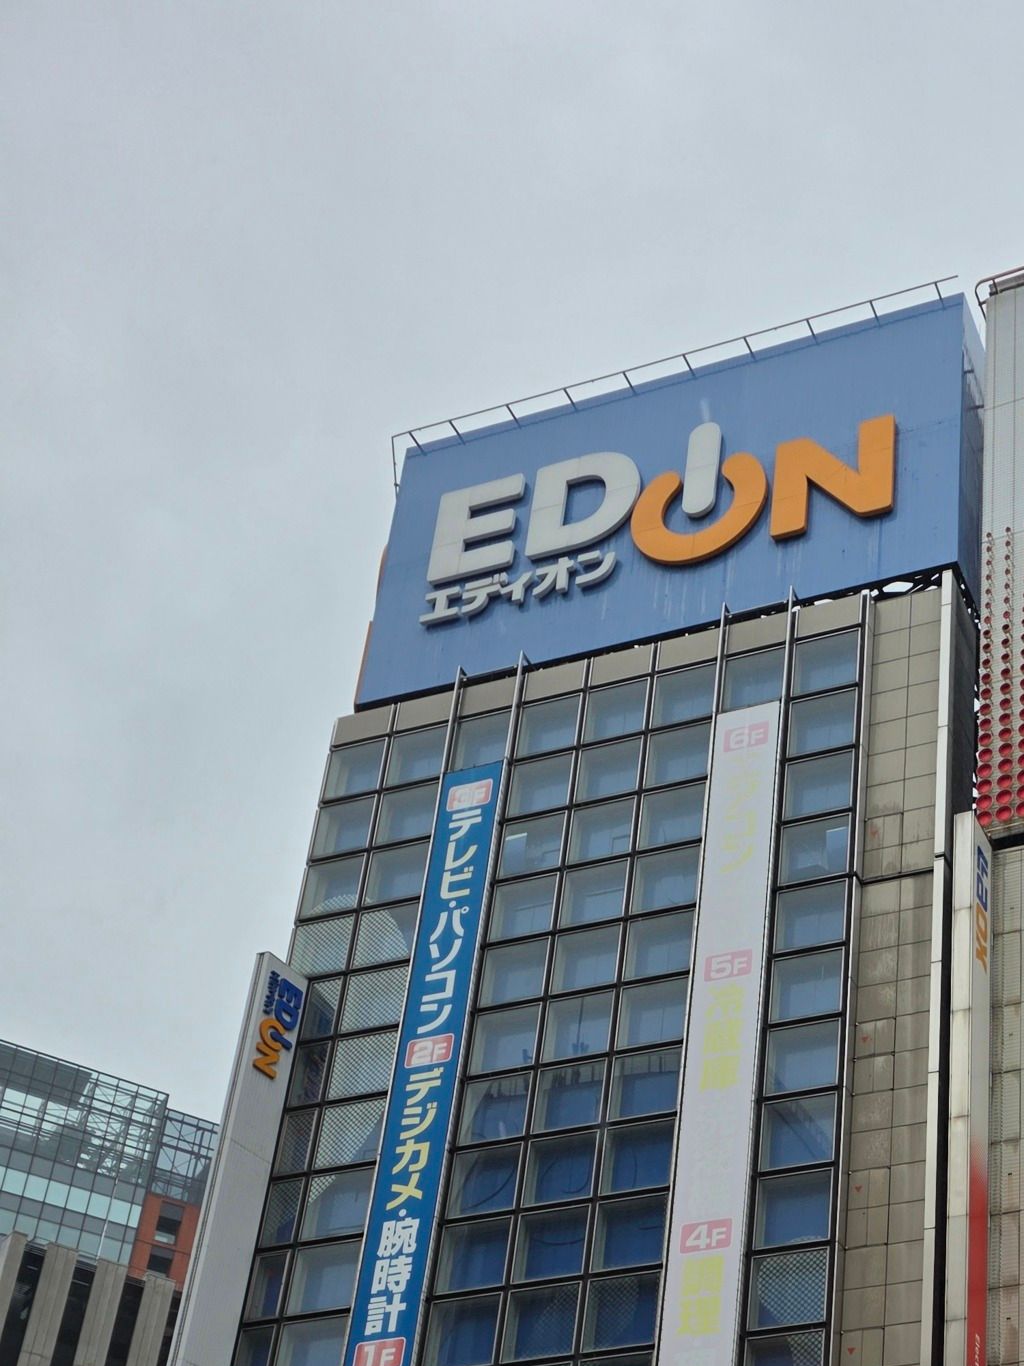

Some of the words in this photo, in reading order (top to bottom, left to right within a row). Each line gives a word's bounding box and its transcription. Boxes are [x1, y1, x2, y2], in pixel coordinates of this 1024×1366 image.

[426, 414, 897, 586] EDION
[419, 550, 617, 627] エディオン
[729, 727, 765, 749] 6F
[710, 956, 748, 977] 5F
[253, 978, 304, 1080] EDION
[411, 1041, 449, 1065] 2F
[686, 1223, 728, 1250] 4F
